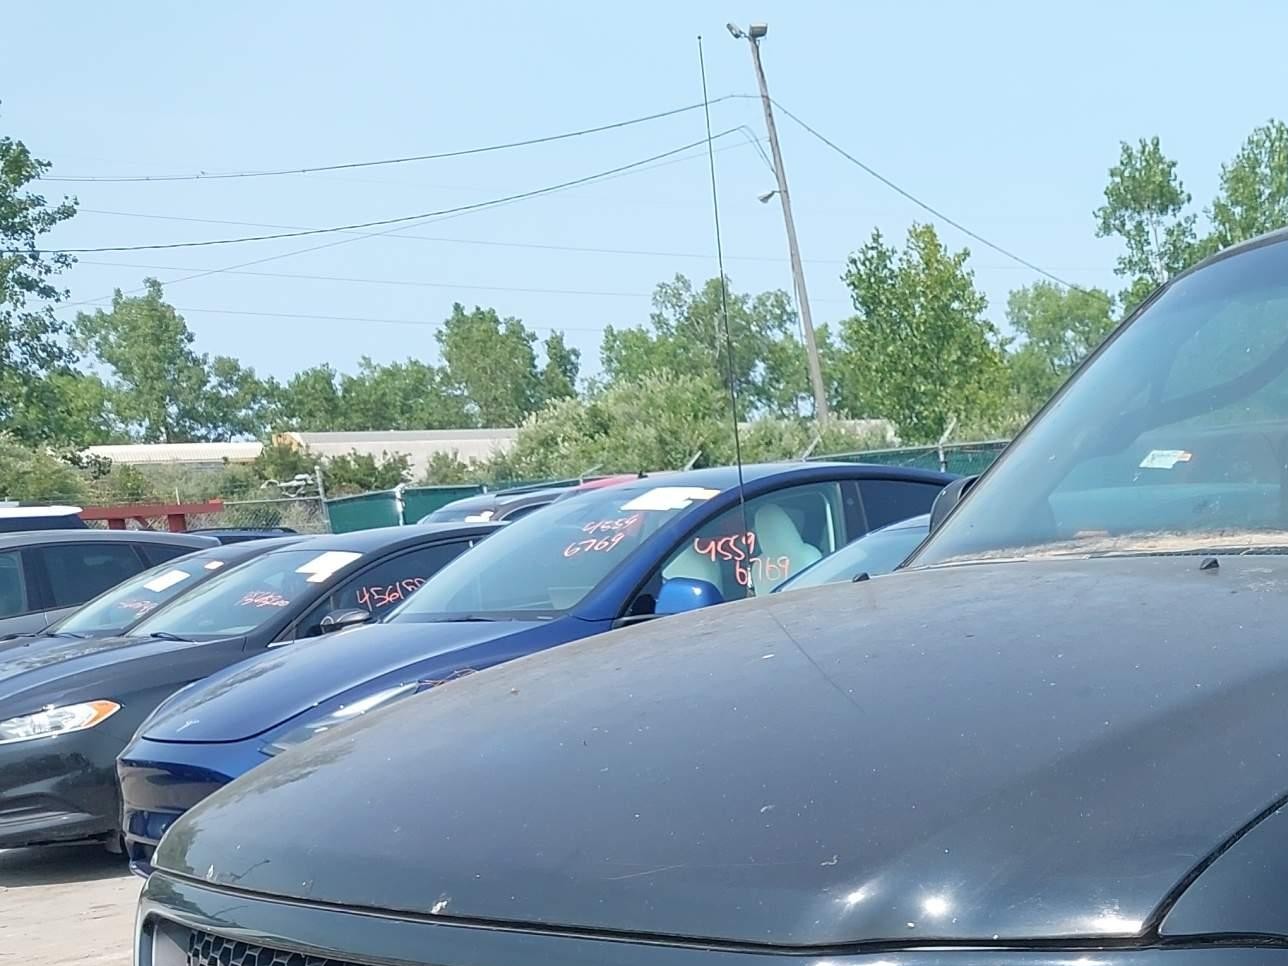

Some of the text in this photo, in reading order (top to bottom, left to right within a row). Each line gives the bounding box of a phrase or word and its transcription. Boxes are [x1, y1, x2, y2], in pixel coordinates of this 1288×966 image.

[563, 533, 624, 557] 6769
[694, 532, 756, 562] 4559
[736, 556, 790, 585] 6769
